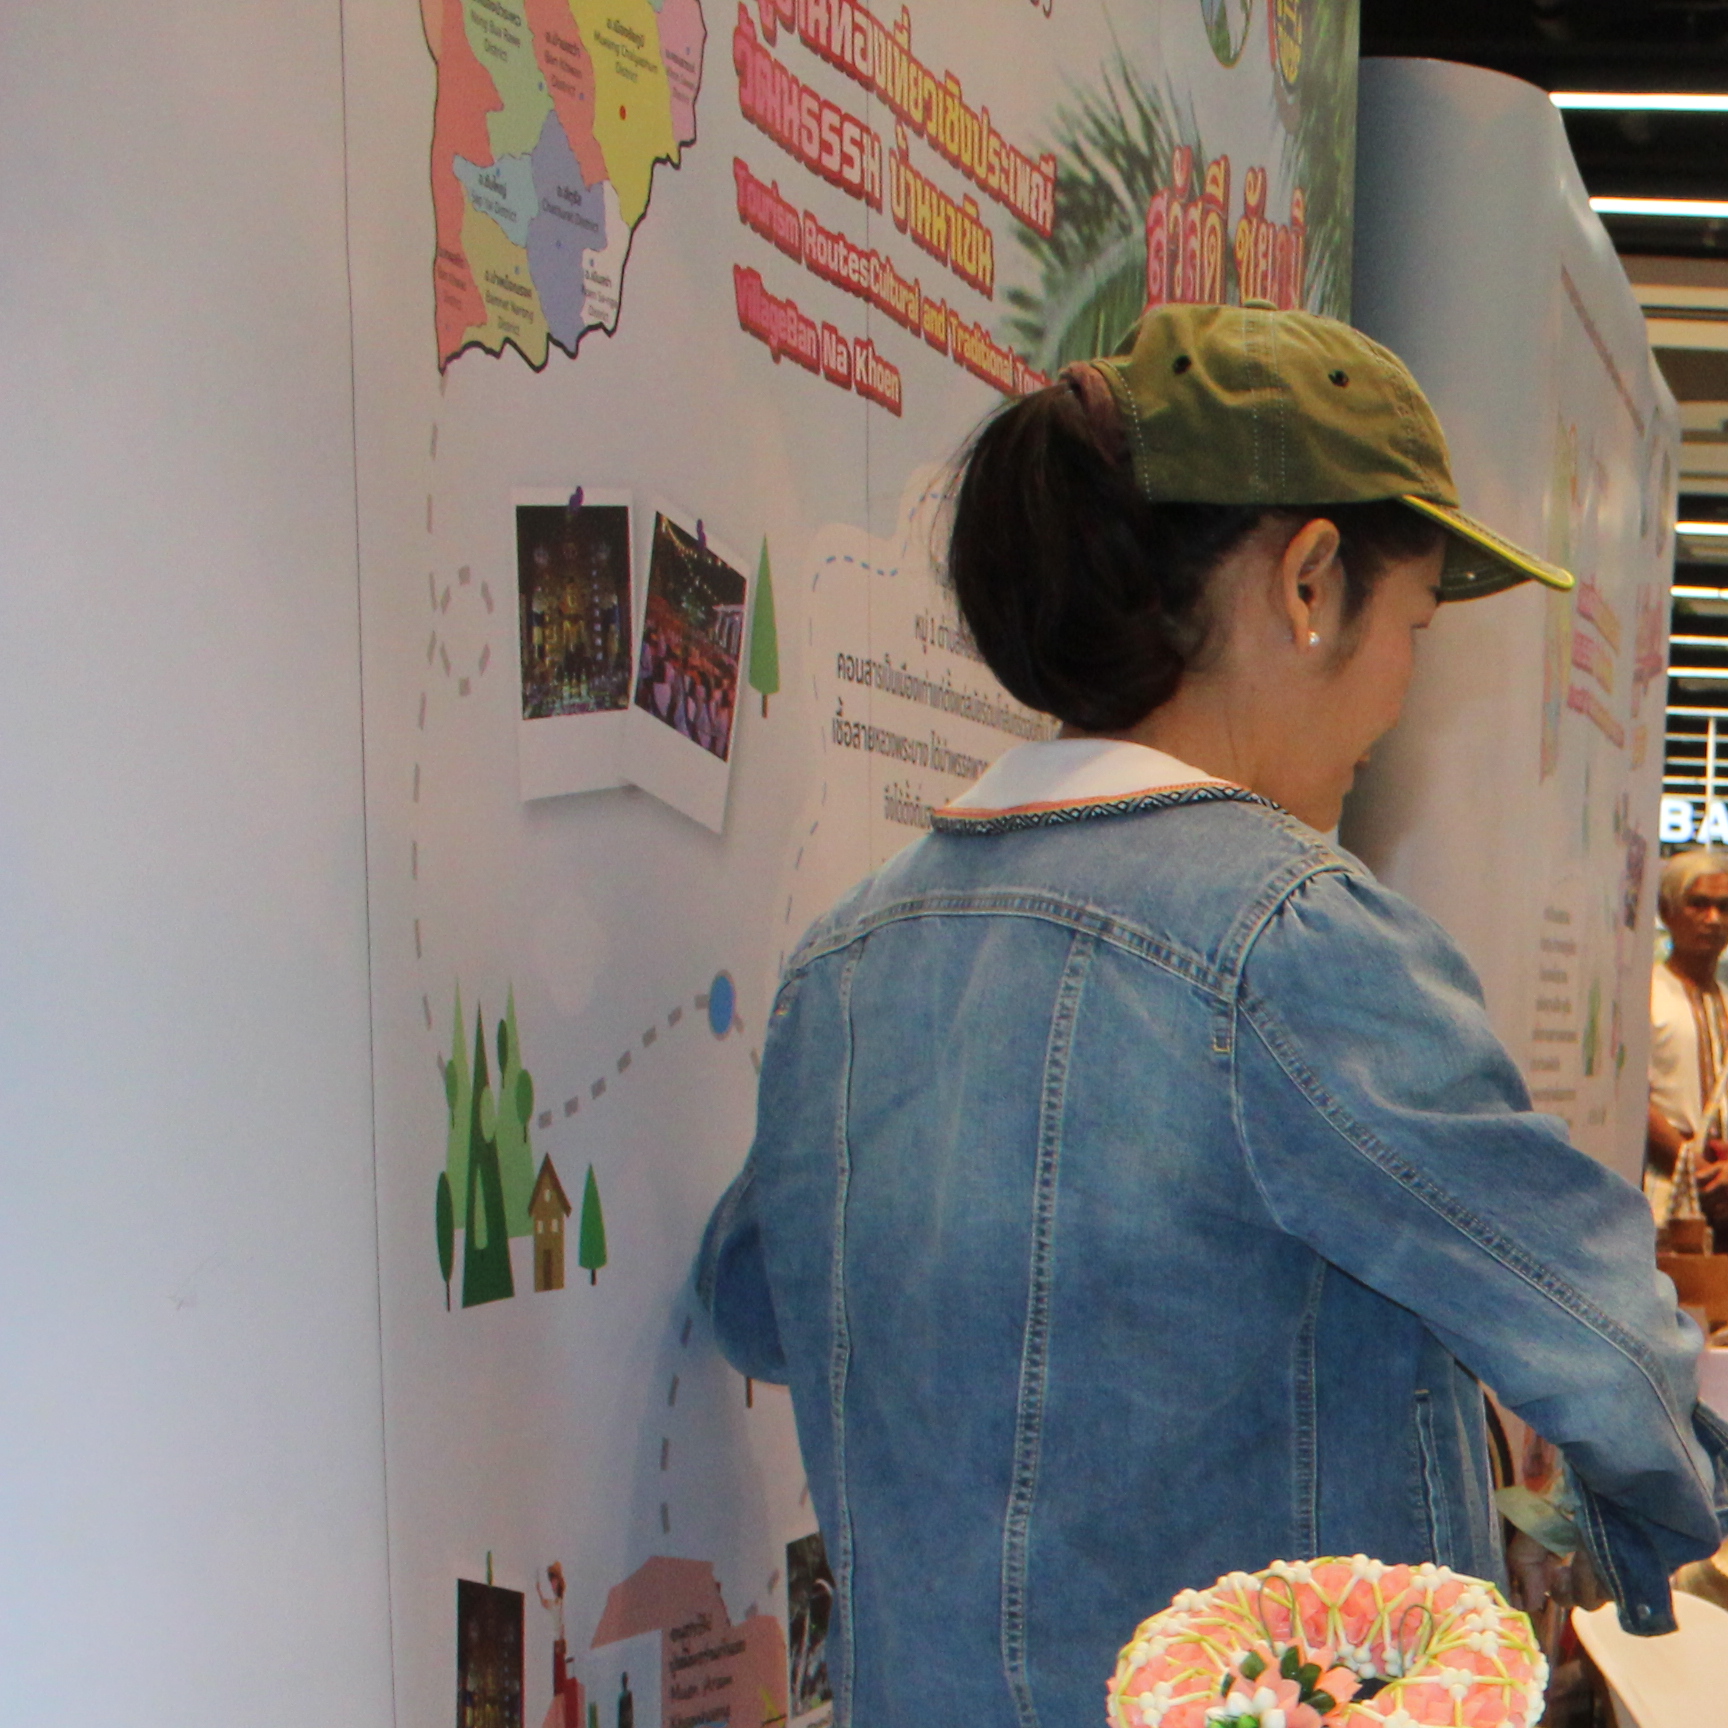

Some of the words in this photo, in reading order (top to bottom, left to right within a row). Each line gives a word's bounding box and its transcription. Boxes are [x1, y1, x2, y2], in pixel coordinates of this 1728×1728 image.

[734, 2, 882, 214] วัฒนธรรม
[734, 156, 803, 264] Tourism
[922, 296, 948, 357] and
[821, 321, 852, 390] Na
[854, 337, 902, 418] Khoen
